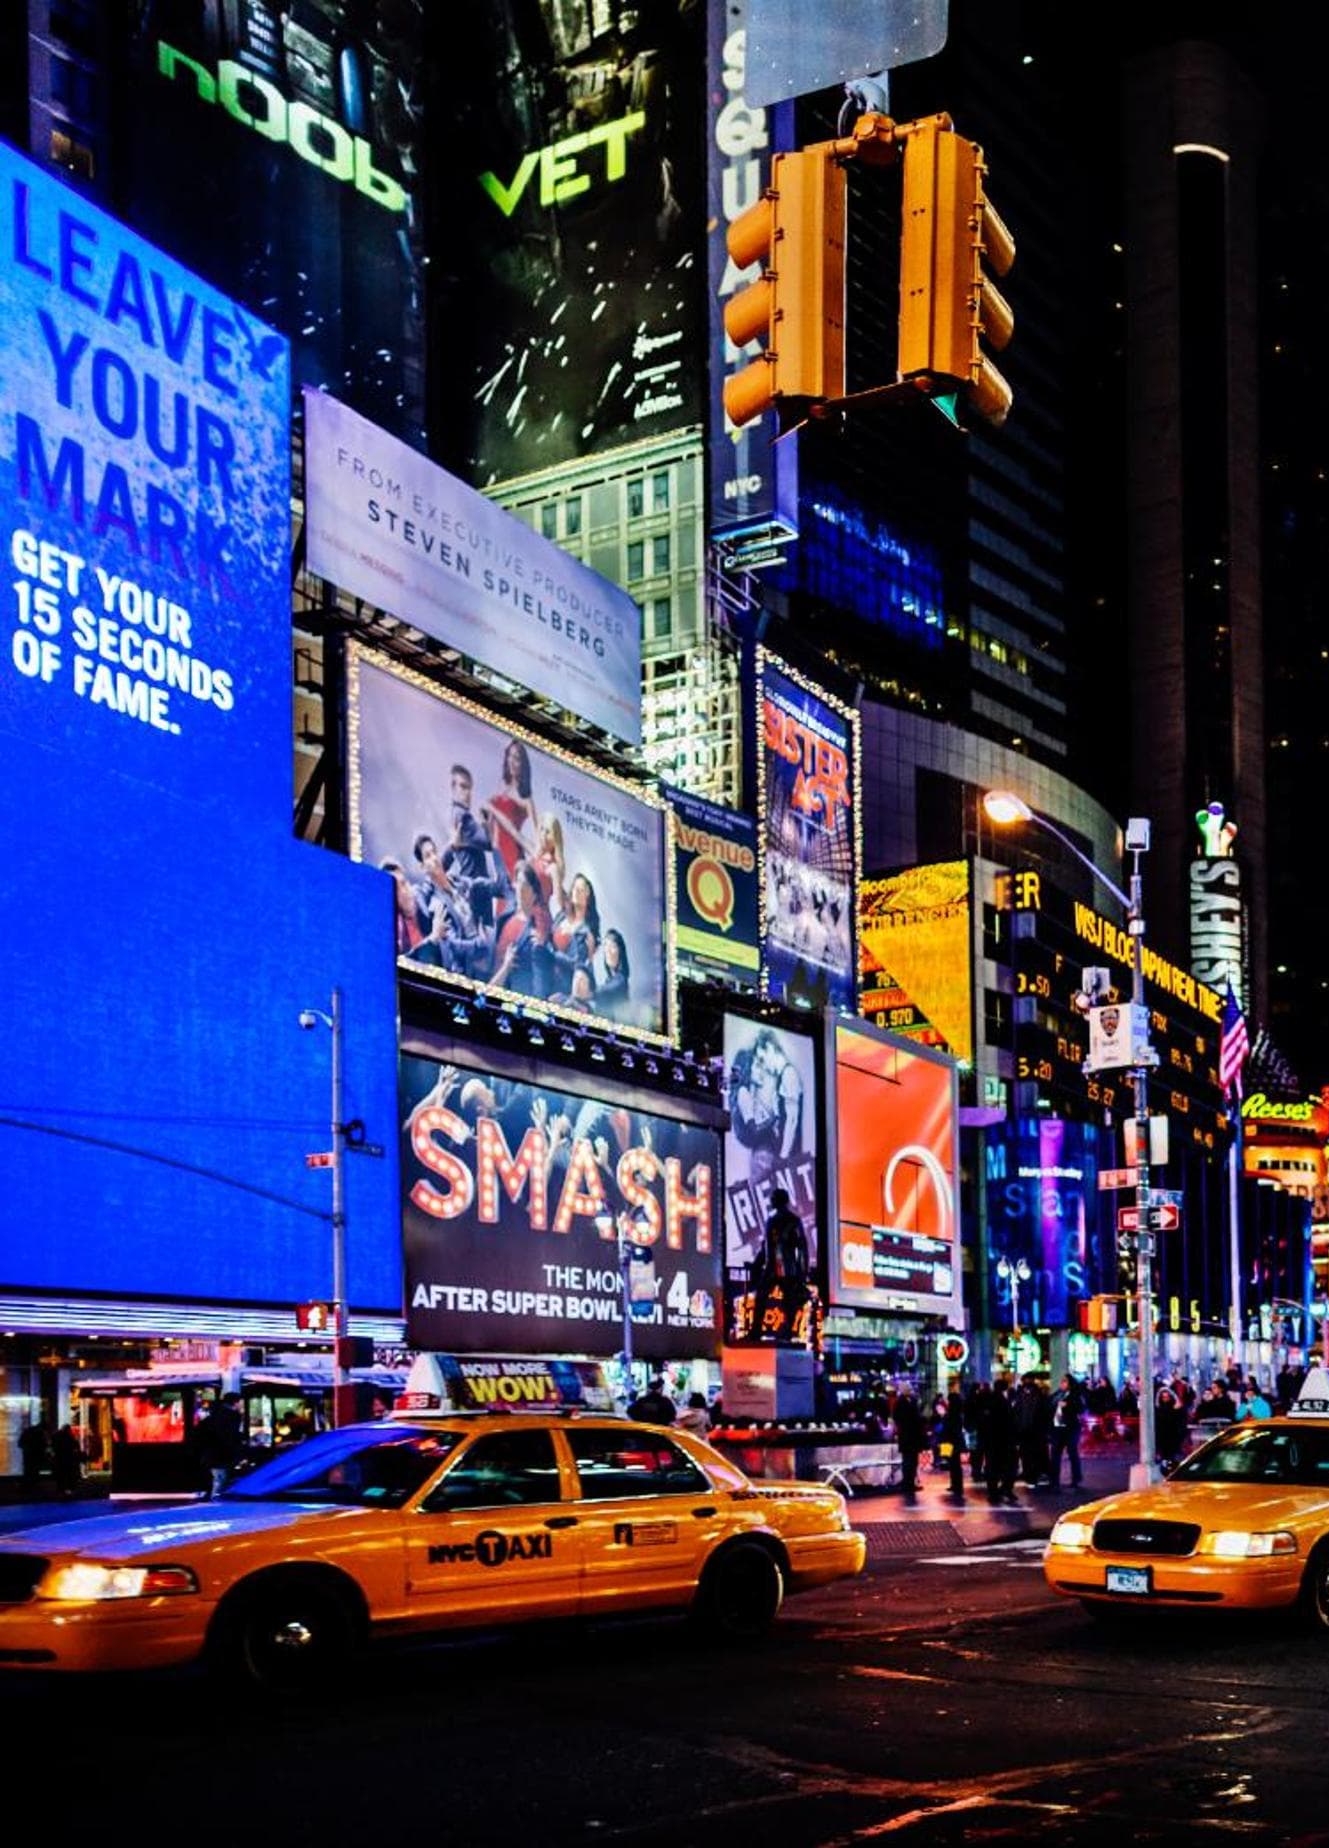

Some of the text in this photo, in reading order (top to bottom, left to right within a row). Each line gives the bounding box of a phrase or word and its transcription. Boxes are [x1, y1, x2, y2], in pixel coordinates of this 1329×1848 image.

[479, 111, 647, 217] VET
[12, 177, 239, 398] LEAVE
[38, 308, 237, 500] YOUR
[724, 474, 762, 499] NYC
[336, 448, 403, 501] FROM
[412, 494, 525, 580] EXECUTIVE
[532, 569, 625, 641] PRODUCER
[367, 500, 471, 579] STEVEN
[482, 569, 606, 658] SPIELBERG
[12, 529, 192, 649] GET YOUR
[13, 581, 235, 711] 15 SECONDS
[12, 630, 182, 736] OF FAME.
[763, 699, 851, 807] SISTER
[791, 767, 836, 830] ACT
[673, 815, 755, 872] Avenue
[686, 855, 735, 932] Q
[1241, 1092, 1315, 1120] Reese's
[410, 1104, 712, 1254] SMASH
[412, 1283, 488, 1312] AFTER
[491, 1289, 564, 1318] SUPER
[566, 1296, 623, 1323] BOWL
[542, 1264, 663, 1298] THE MONY
[667, 1271, 690, 1316] 4
[667, 1315, 690, 1327] NEW
[461, 1362, 549, 1377] NOW MORE
[467, 1375, 557, 1403] WOW!
[428, 1530, 552, 1566] NYC TAXI
